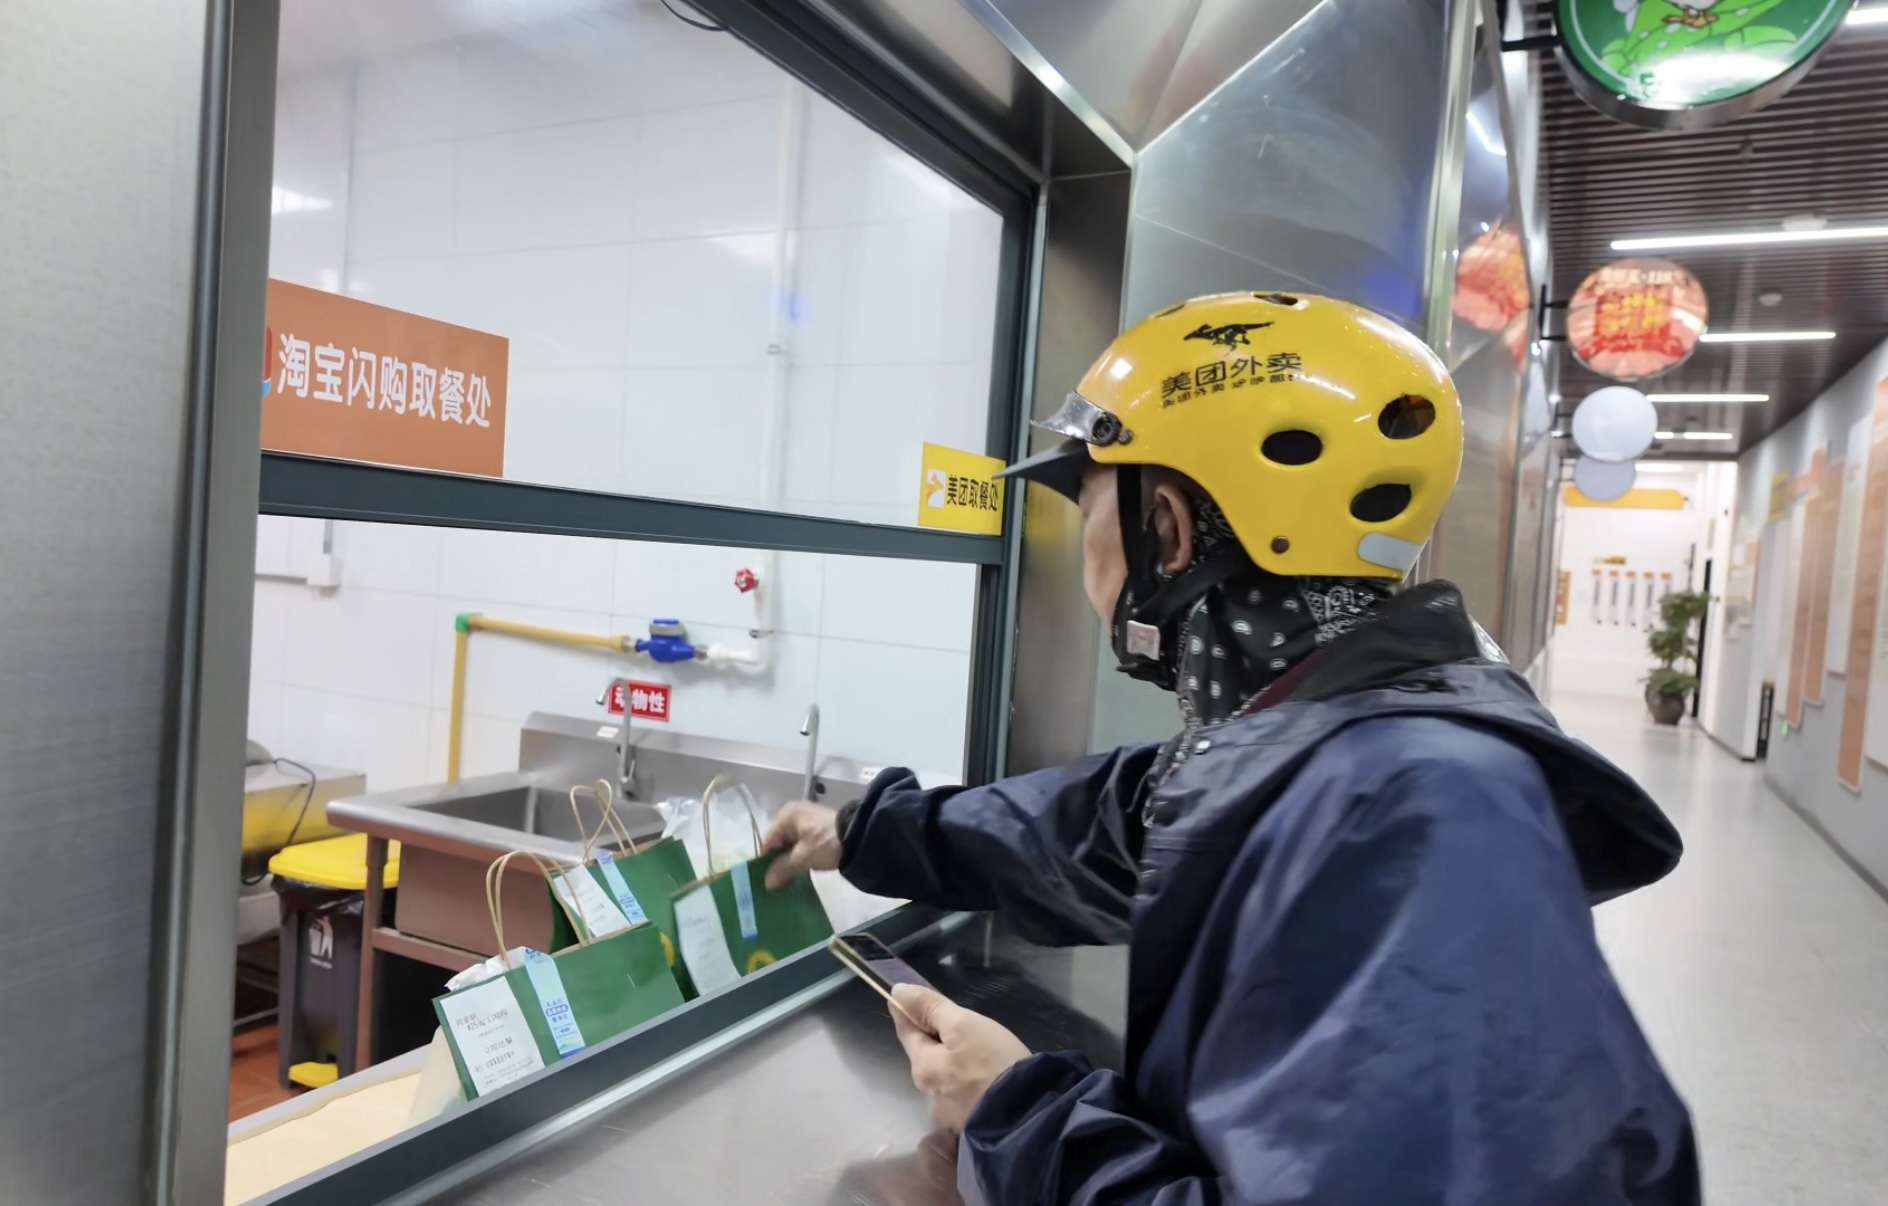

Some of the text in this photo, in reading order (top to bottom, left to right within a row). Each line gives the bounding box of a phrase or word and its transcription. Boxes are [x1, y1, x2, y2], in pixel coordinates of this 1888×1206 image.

[277, 333, 492, 428] 淘宝闪购取餐处
[1161, 352, 1302, 398] 美团外卖
[946, 475, 999, 512] 美团取餐处
